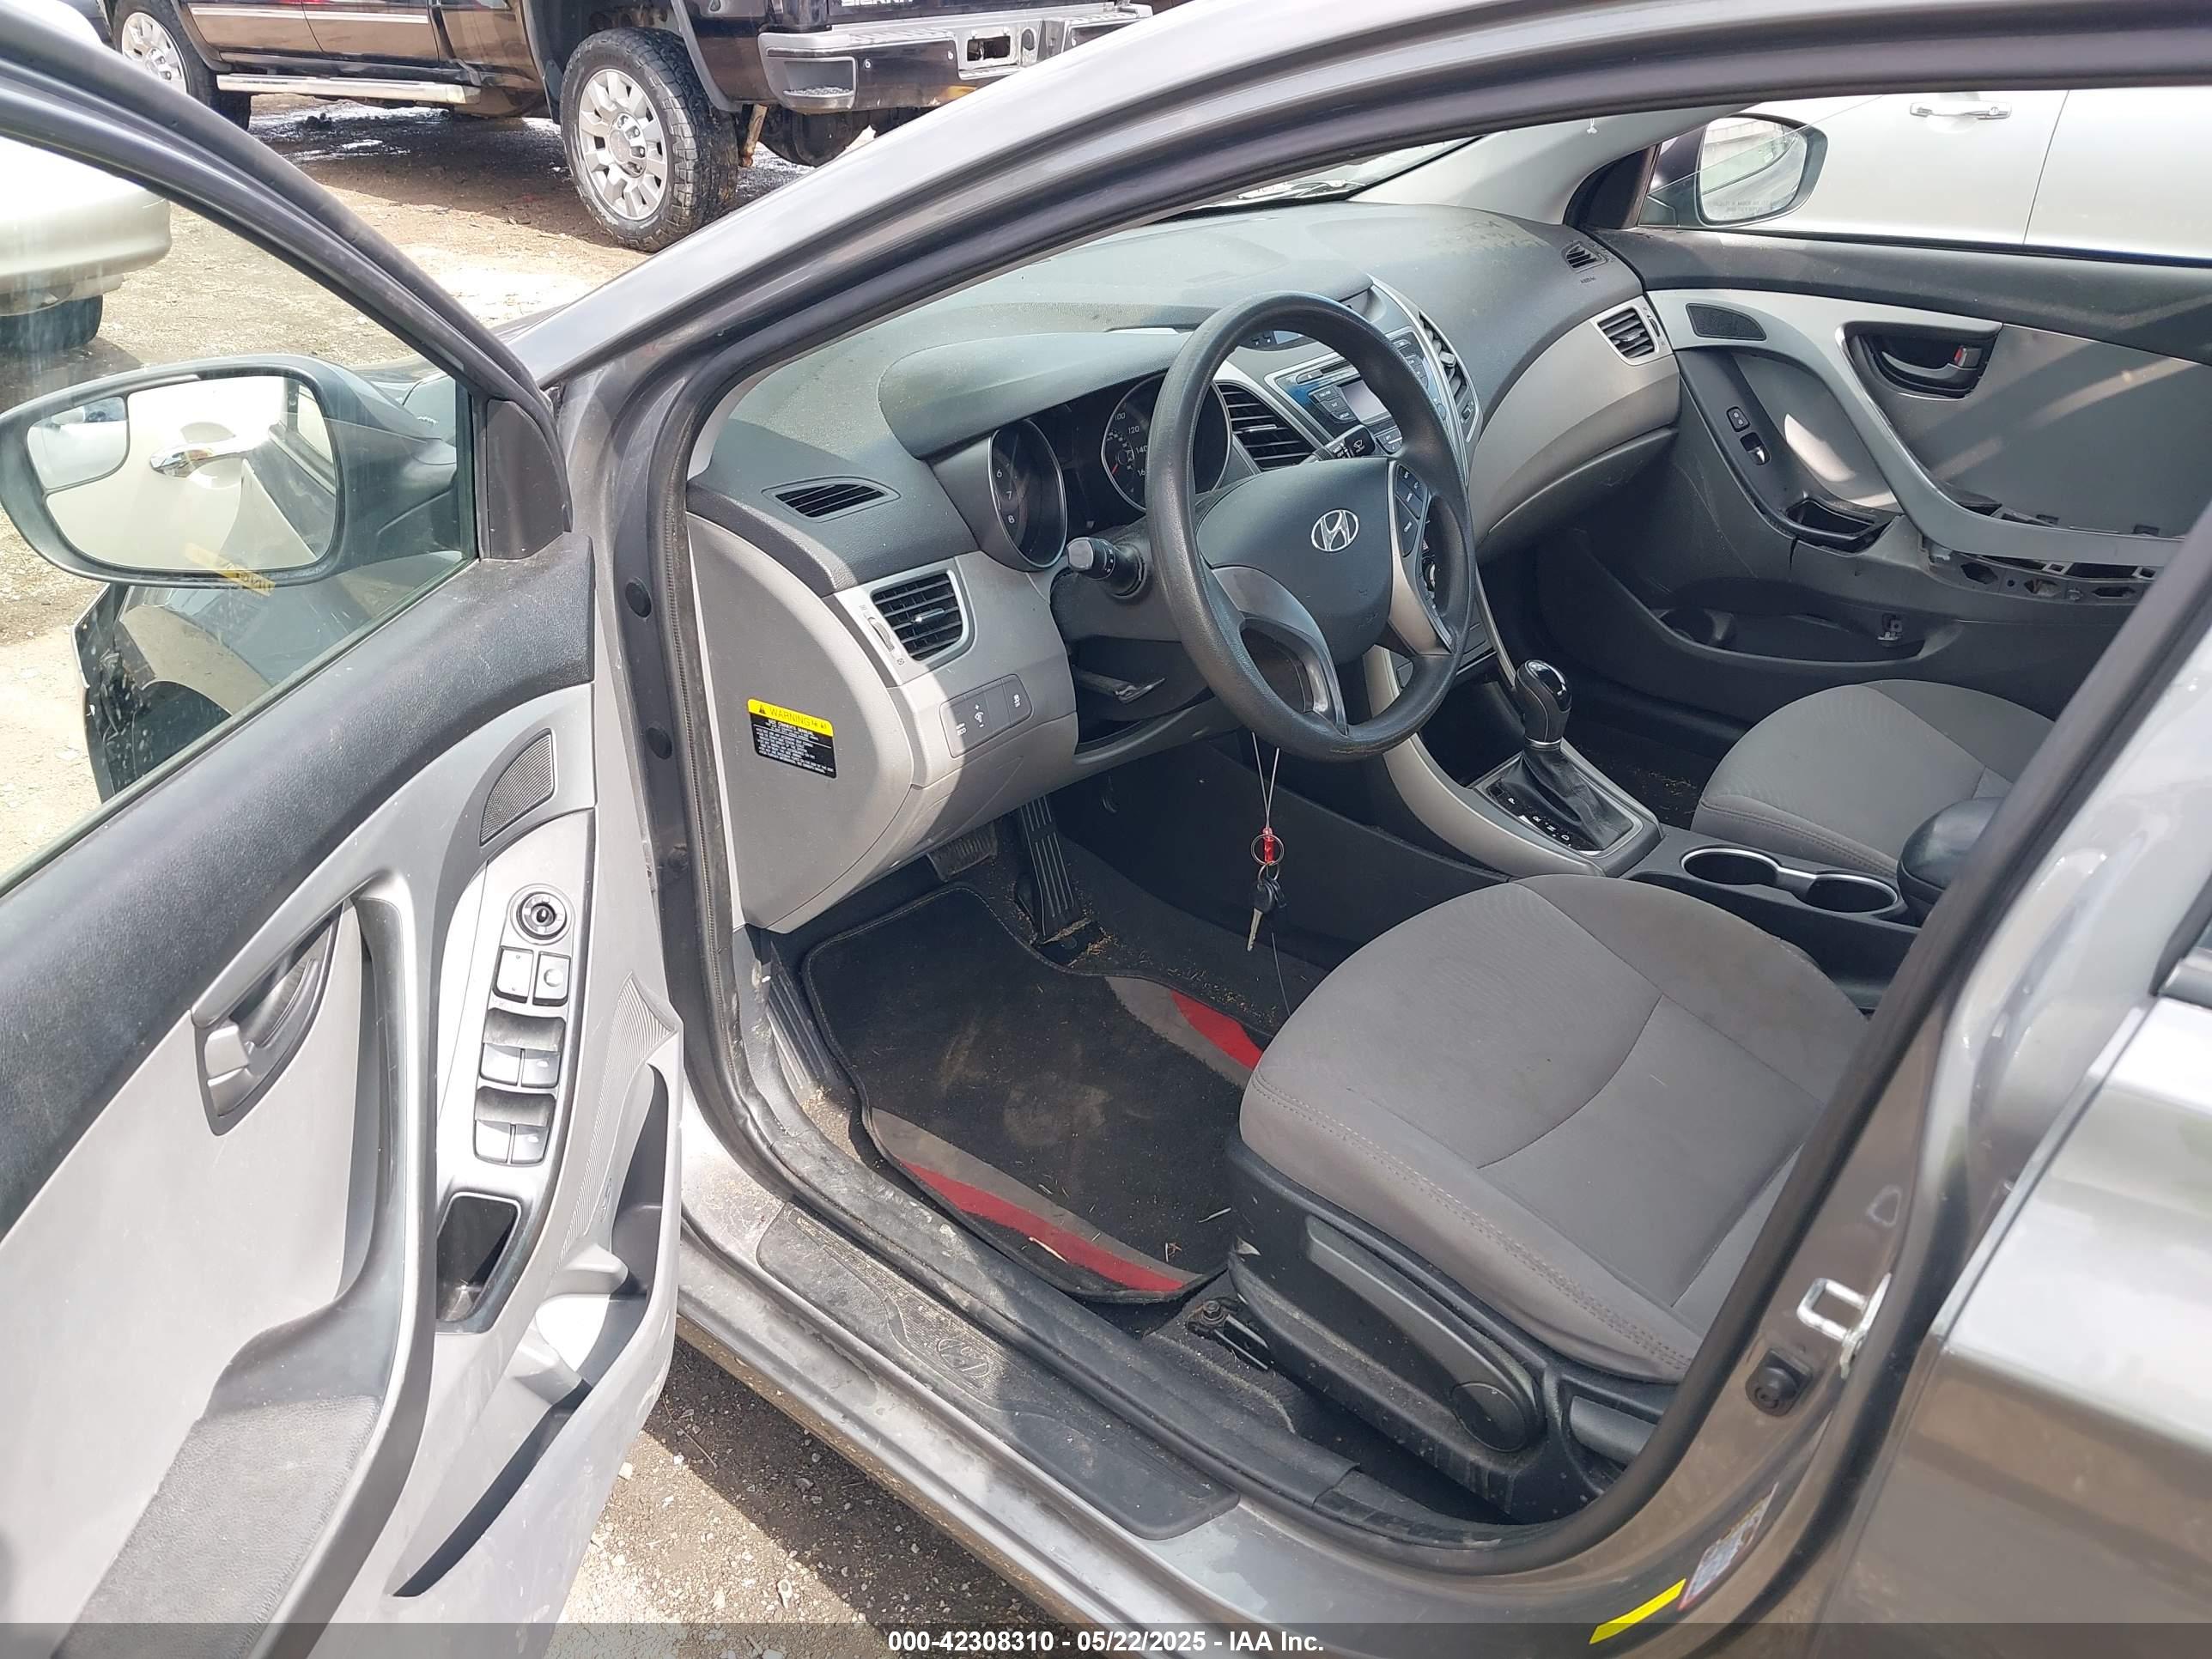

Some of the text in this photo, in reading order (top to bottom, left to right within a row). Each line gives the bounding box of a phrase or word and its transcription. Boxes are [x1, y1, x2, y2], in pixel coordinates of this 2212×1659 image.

[996, 469, 1003, 478] 6
[1138, 468, 1146, 477] 16
[1006, 490, 1012, 500] 7
[1007, 515, 1015, 524] 8
[769, 707, 811, 726] WARNING
